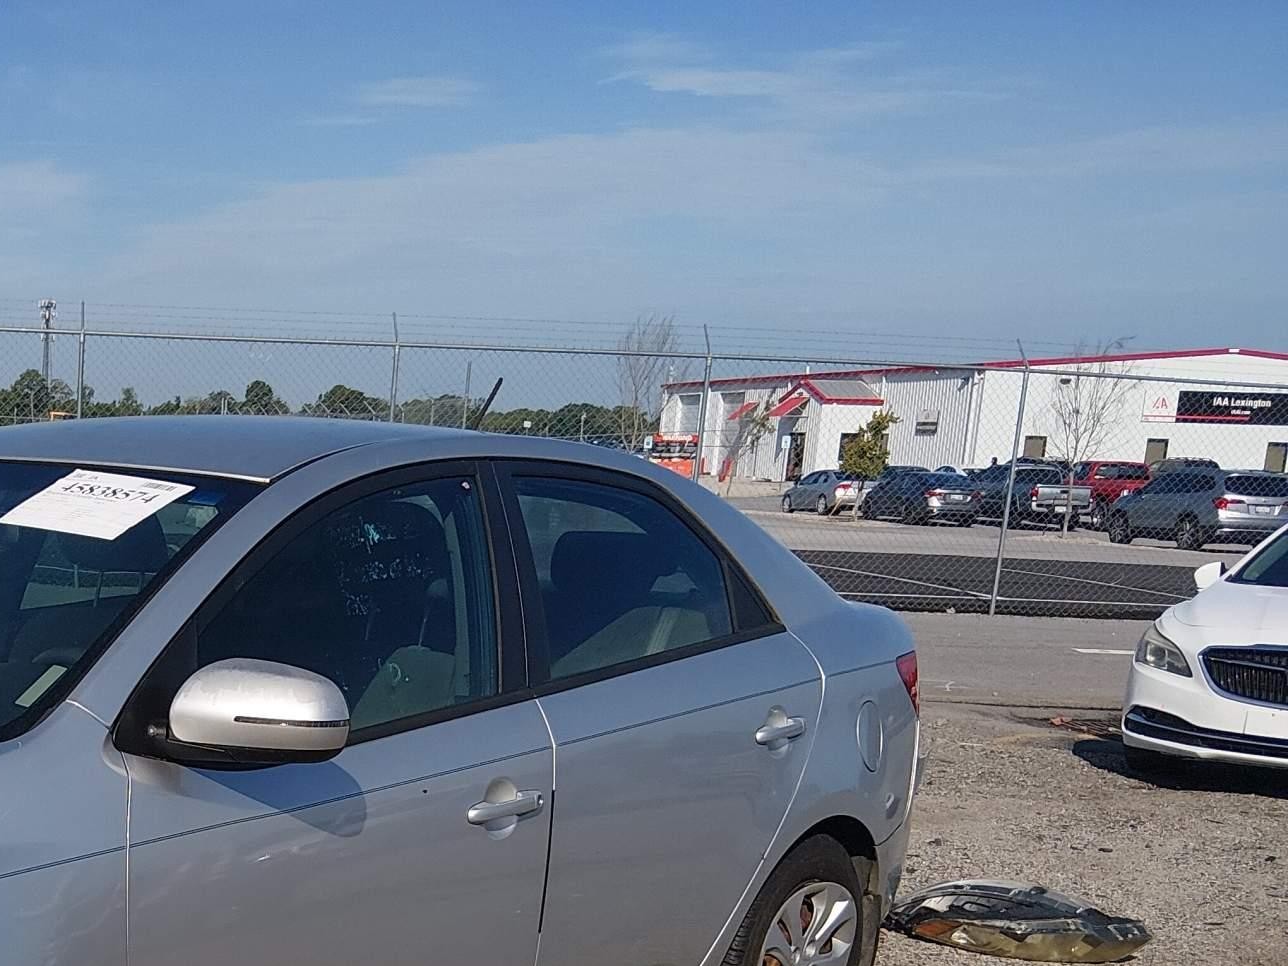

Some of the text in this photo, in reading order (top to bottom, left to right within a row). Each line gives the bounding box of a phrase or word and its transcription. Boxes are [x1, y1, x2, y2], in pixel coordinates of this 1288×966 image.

[1212, 396, 1272, 408] IAA Lexington
[61, 481, 160, 504] 45838574
